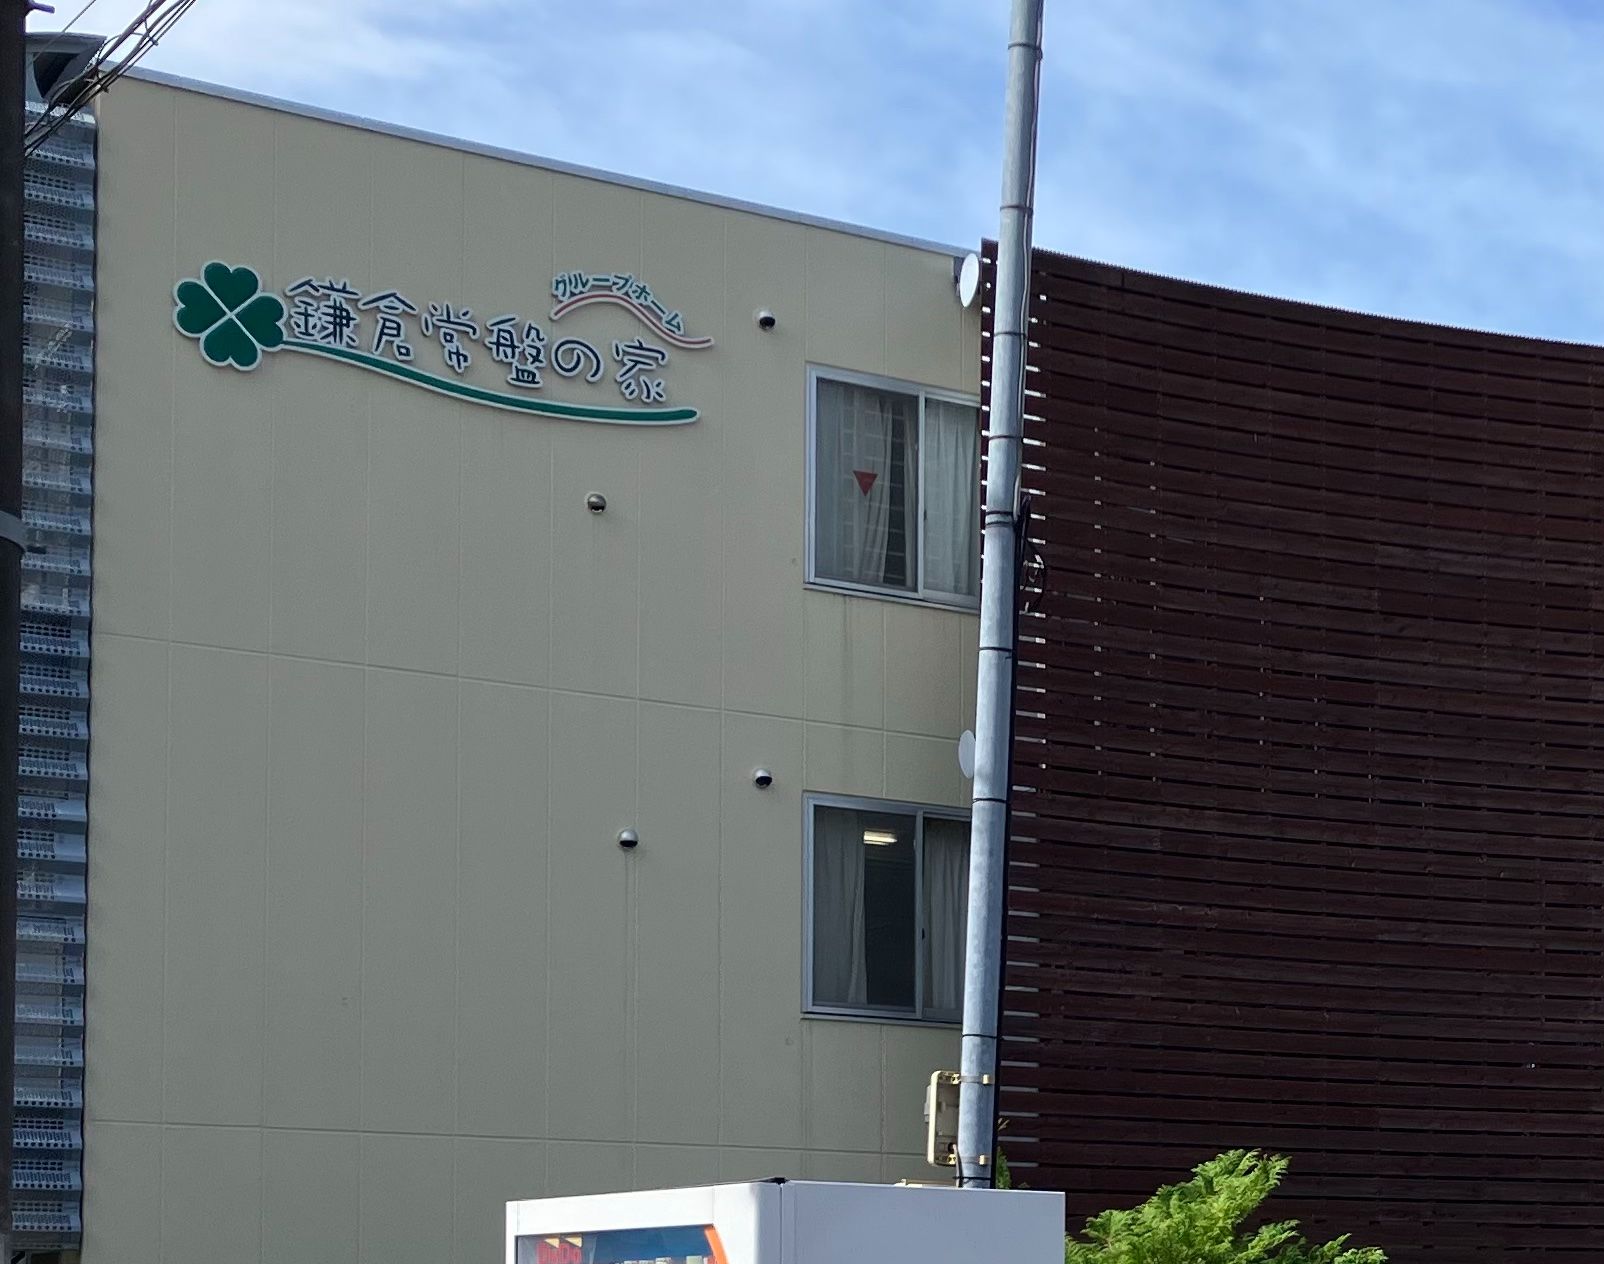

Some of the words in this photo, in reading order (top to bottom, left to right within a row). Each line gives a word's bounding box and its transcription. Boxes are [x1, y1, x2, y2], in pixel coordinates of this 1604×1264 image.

[286, 278, 666, 401] 鎌倉常盤の家
[553, 271, 685, 334] グループホーム
